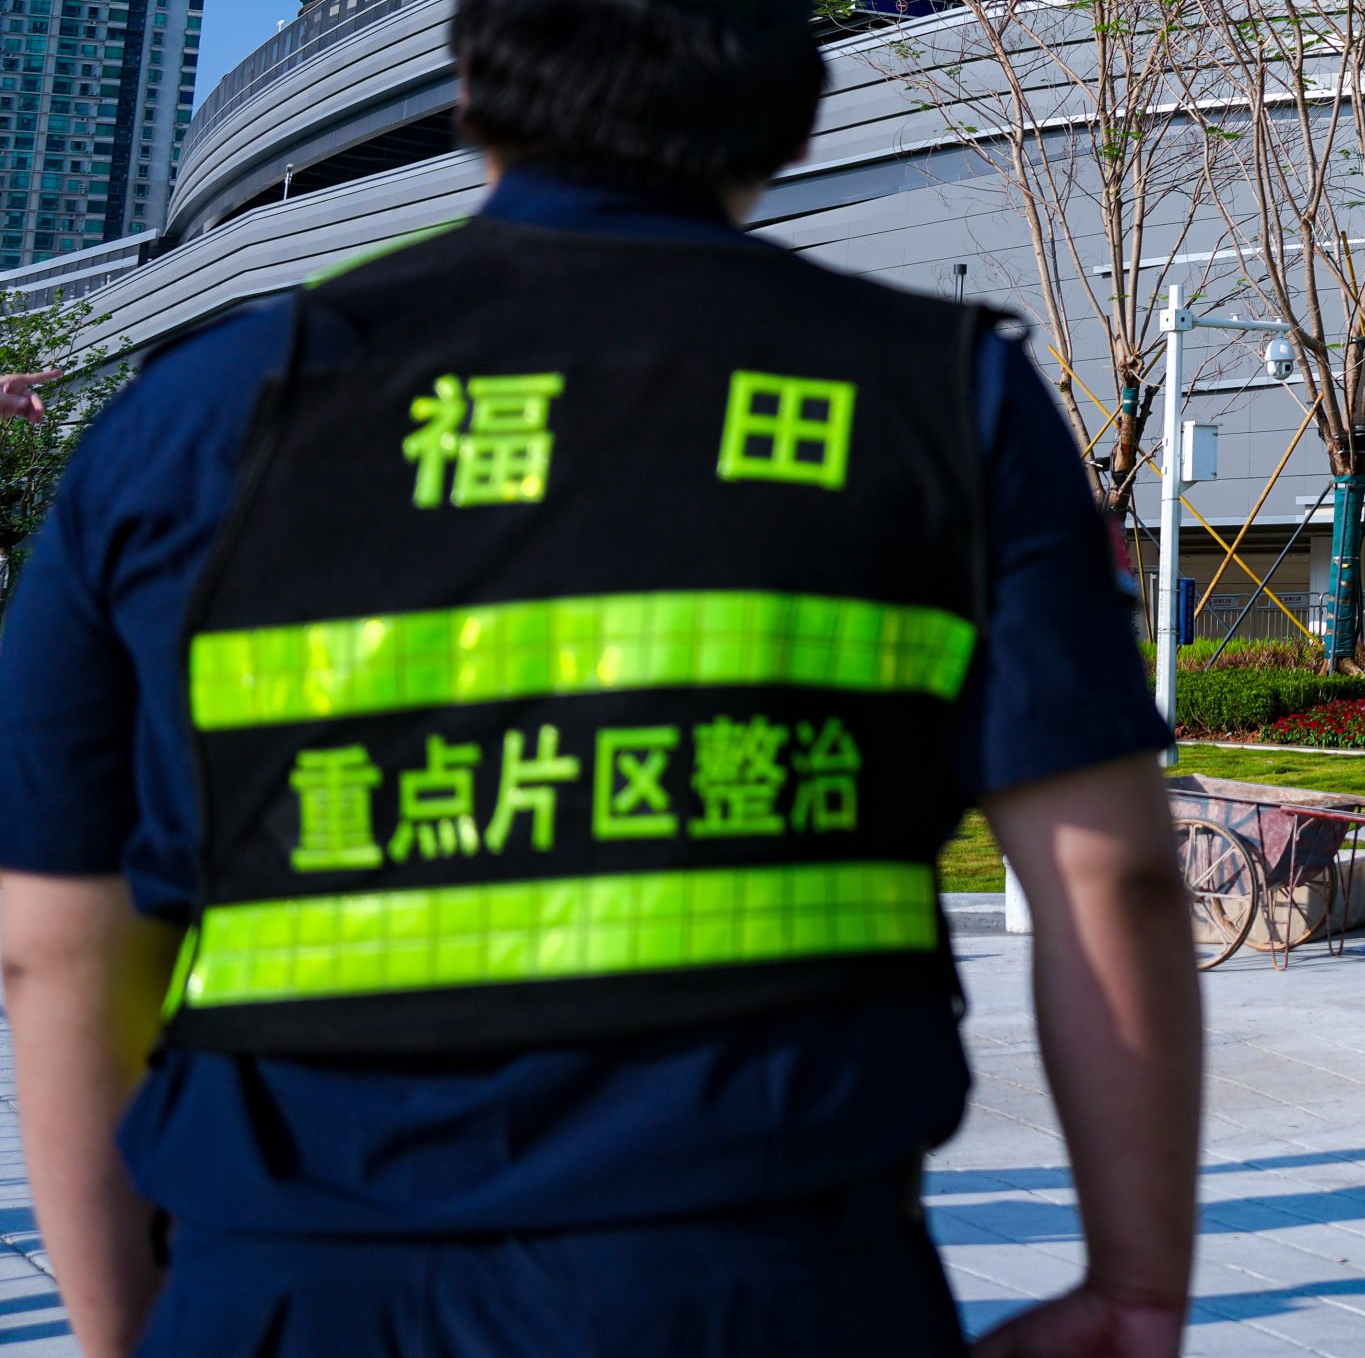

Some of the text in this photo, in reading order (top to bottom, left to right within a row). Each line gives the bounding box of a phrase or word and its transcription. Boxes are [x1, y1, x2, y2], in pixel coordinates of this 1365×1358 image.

[402, 371, 857, 509] 福田
[288, 714, 862, 873] 重点片区整治
